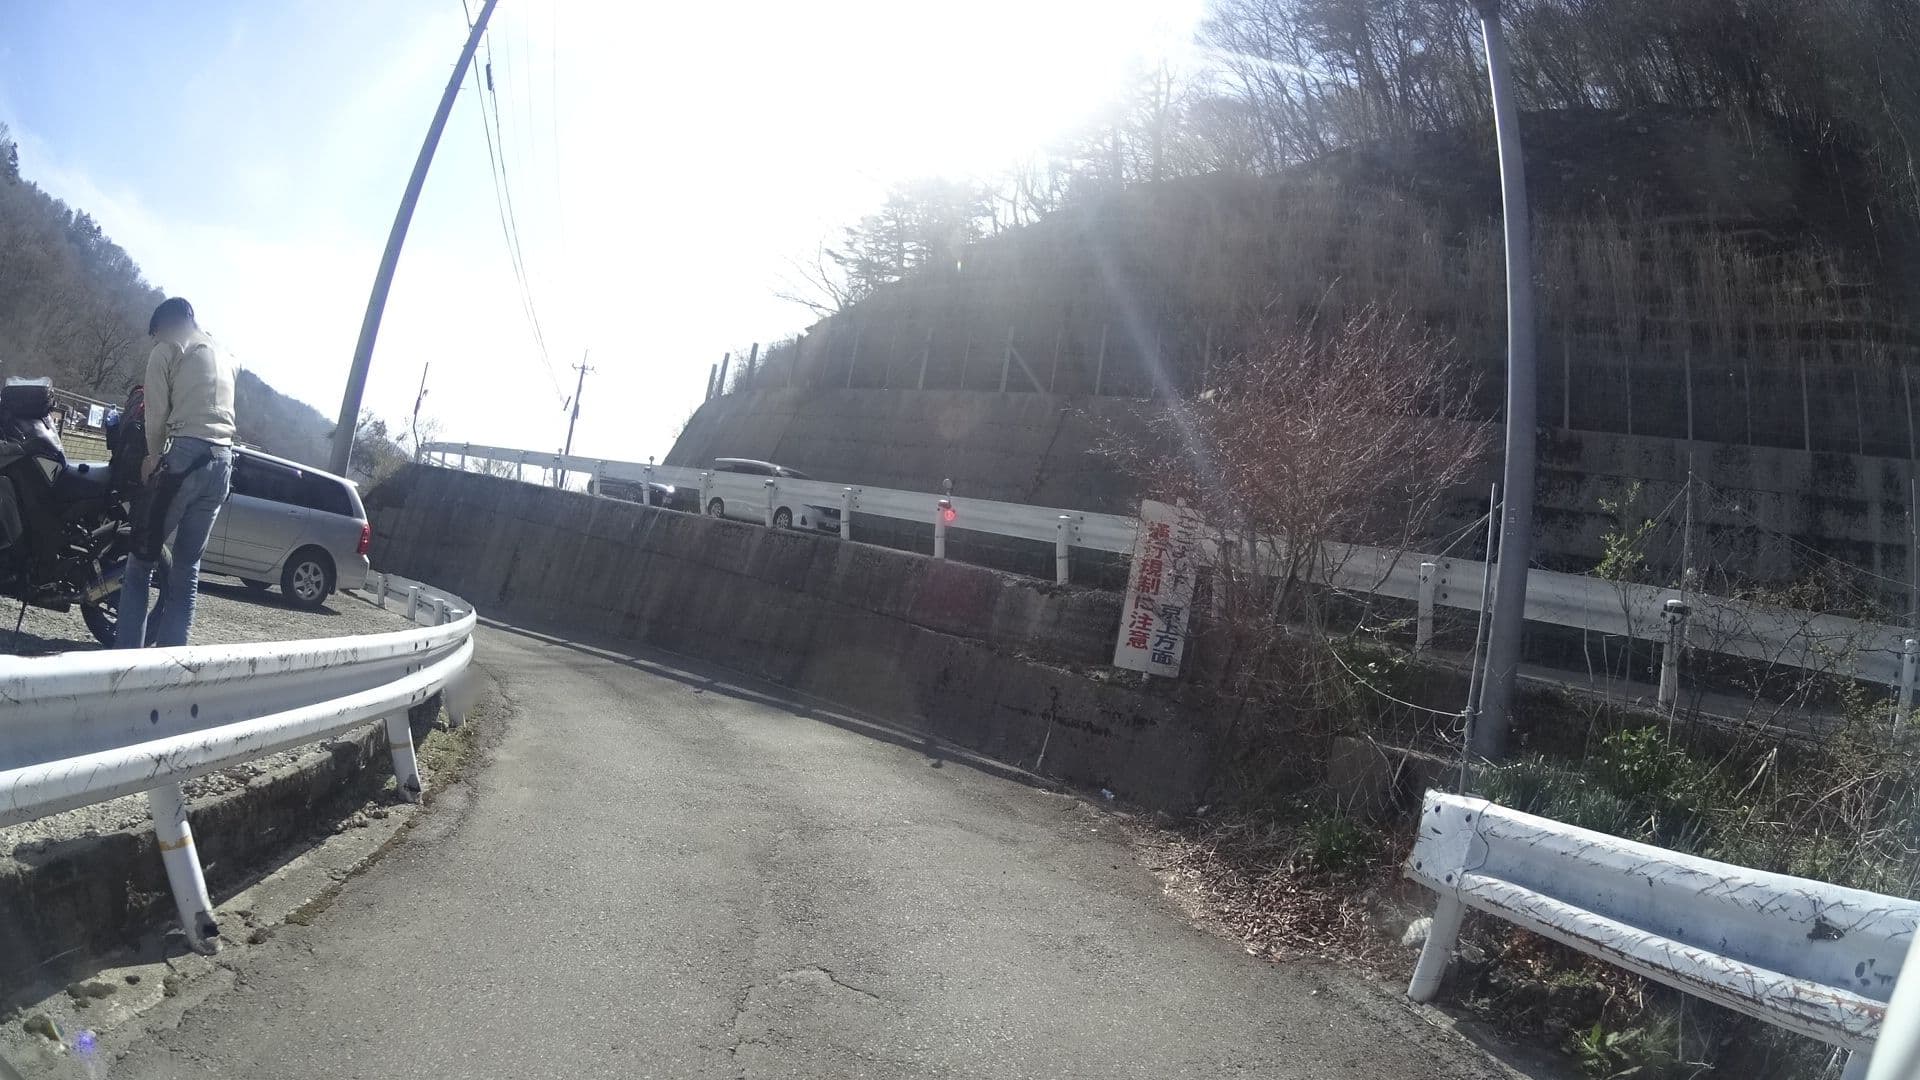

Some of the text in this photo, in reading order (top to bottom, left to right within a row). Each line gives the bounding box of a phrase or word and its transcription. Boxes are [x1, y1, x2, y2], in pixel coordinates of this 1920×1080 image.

[1126, 521, 1171, 651] 通行規制に注意
